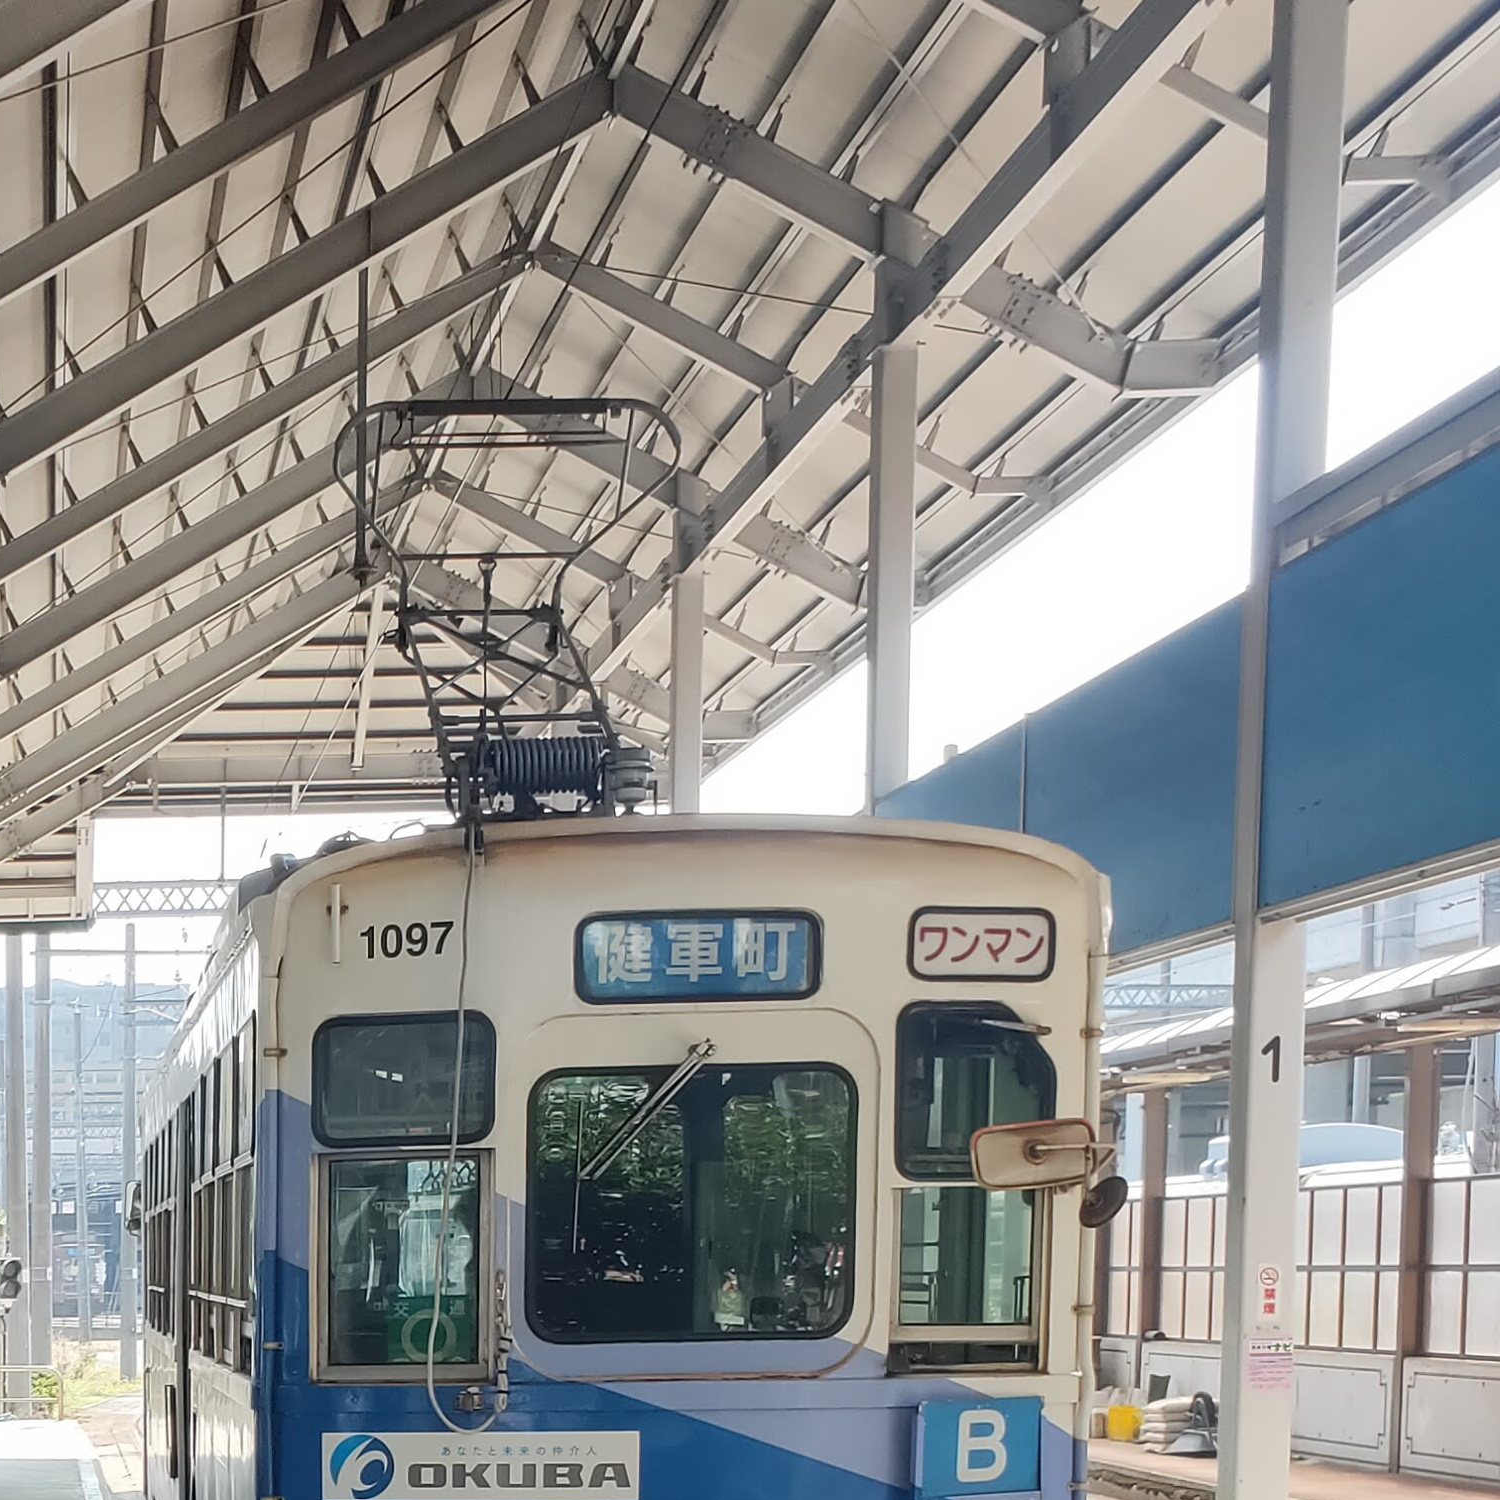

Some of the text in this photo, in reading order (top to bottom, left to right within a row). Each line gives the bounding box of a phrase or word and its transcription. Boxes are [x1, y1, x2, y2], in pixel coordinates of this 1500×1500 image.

[359, 920, 455, 960] 1097
[595, 918, 797, 984] 健軍町
[919, 925, 1045, 964] ワンマン
[1261, 1035, 1281, 1084] 1
[441, 1445, 598, 1457] あなたと未来の仲介人
[956, 1409, 1007, 1484] B
[407, 1463, 631, 1488] OKUBA
